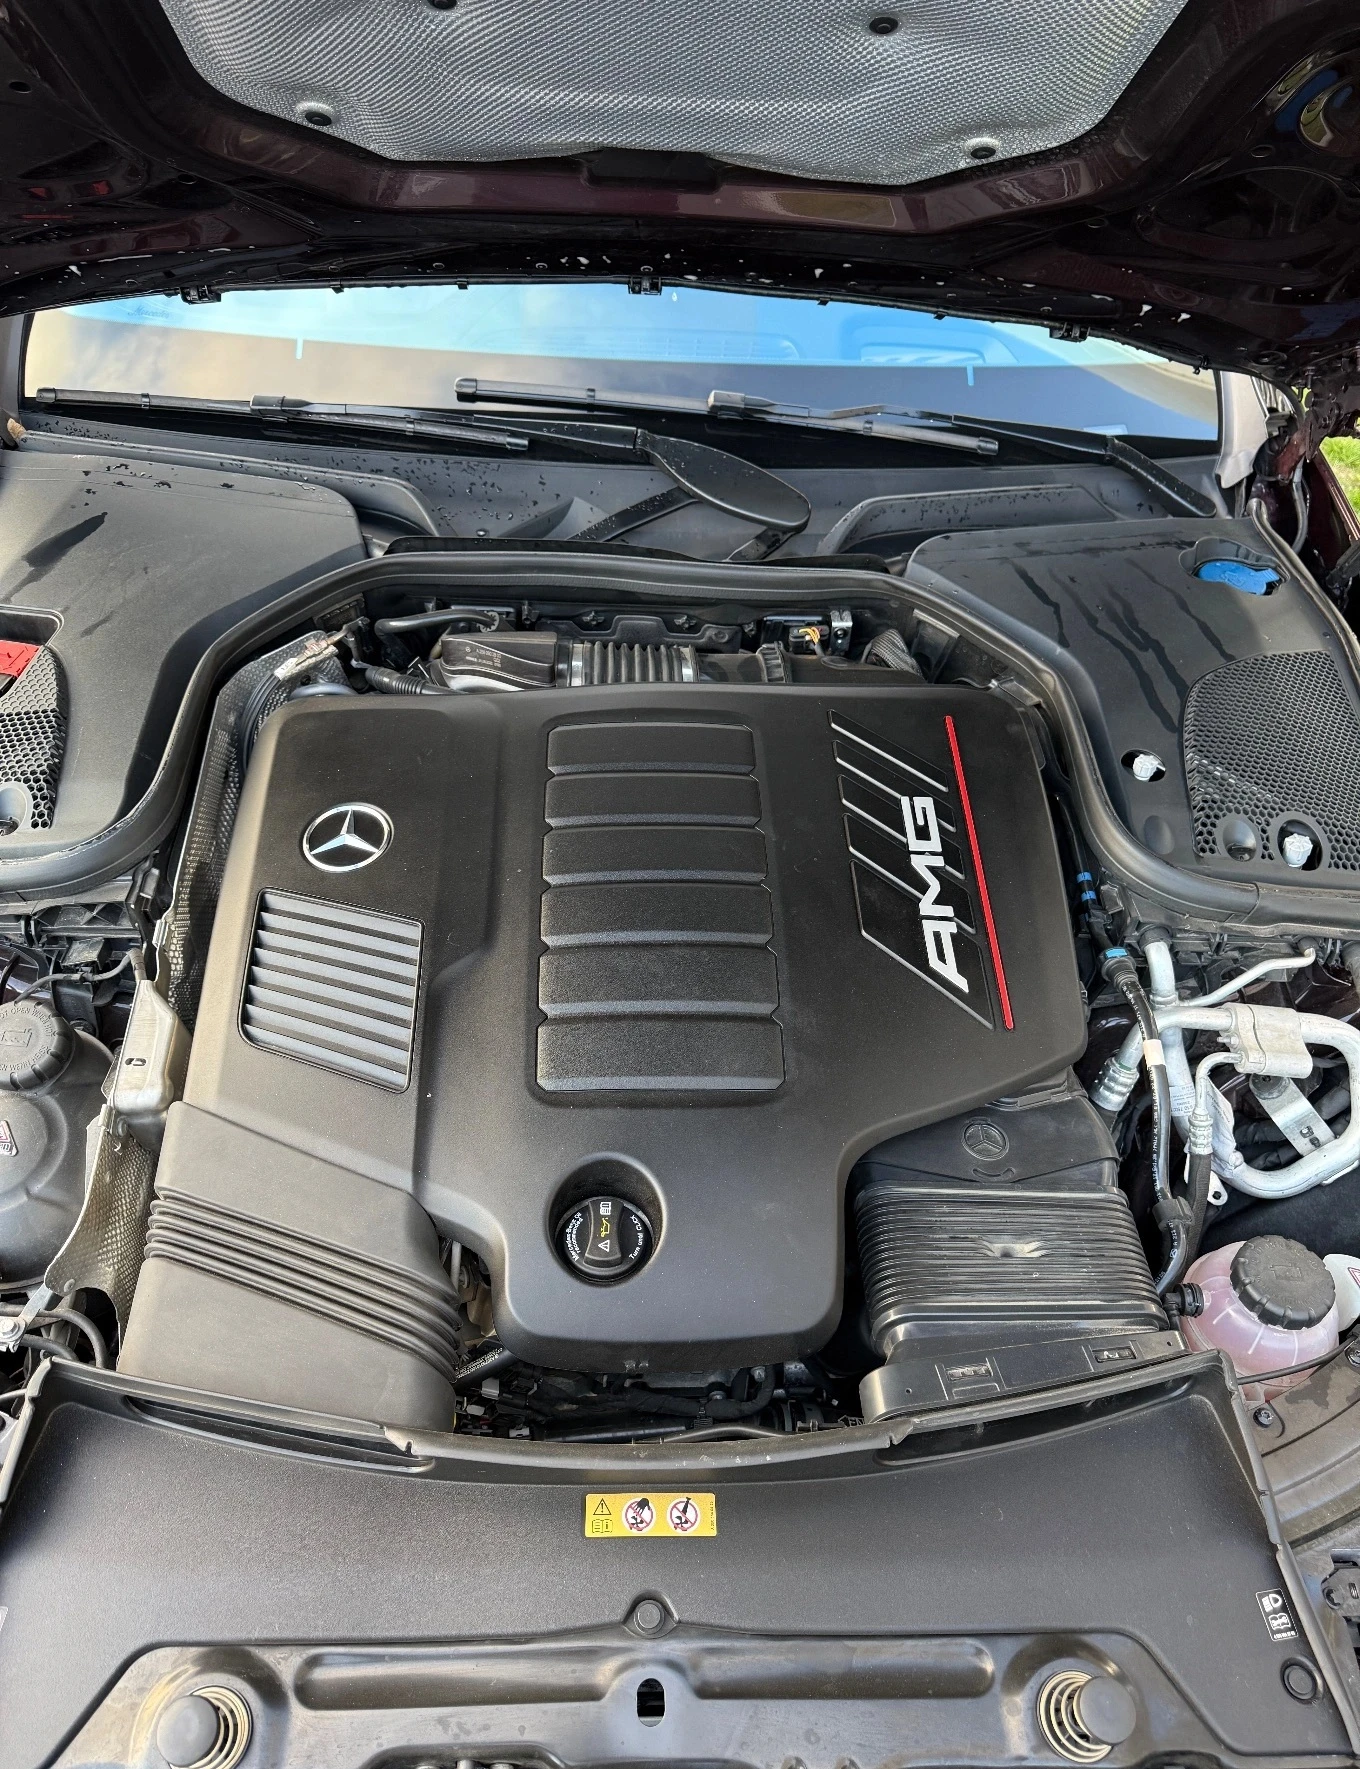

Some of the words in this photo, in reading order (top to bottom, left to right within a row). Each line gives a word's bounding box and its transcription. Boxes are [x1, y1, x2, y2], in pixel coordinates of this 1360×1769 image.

[900, 796, 969, 993] AMG
[11, 1007, 31, 1015] OPEN
[32, 1008, 50, 1024] WHEN
[565, 1219, 580, 1261] Mercedes-Benz
[571, 1218, 583, 1254] recommended
[628, 1247, 641, 1260] Turn
